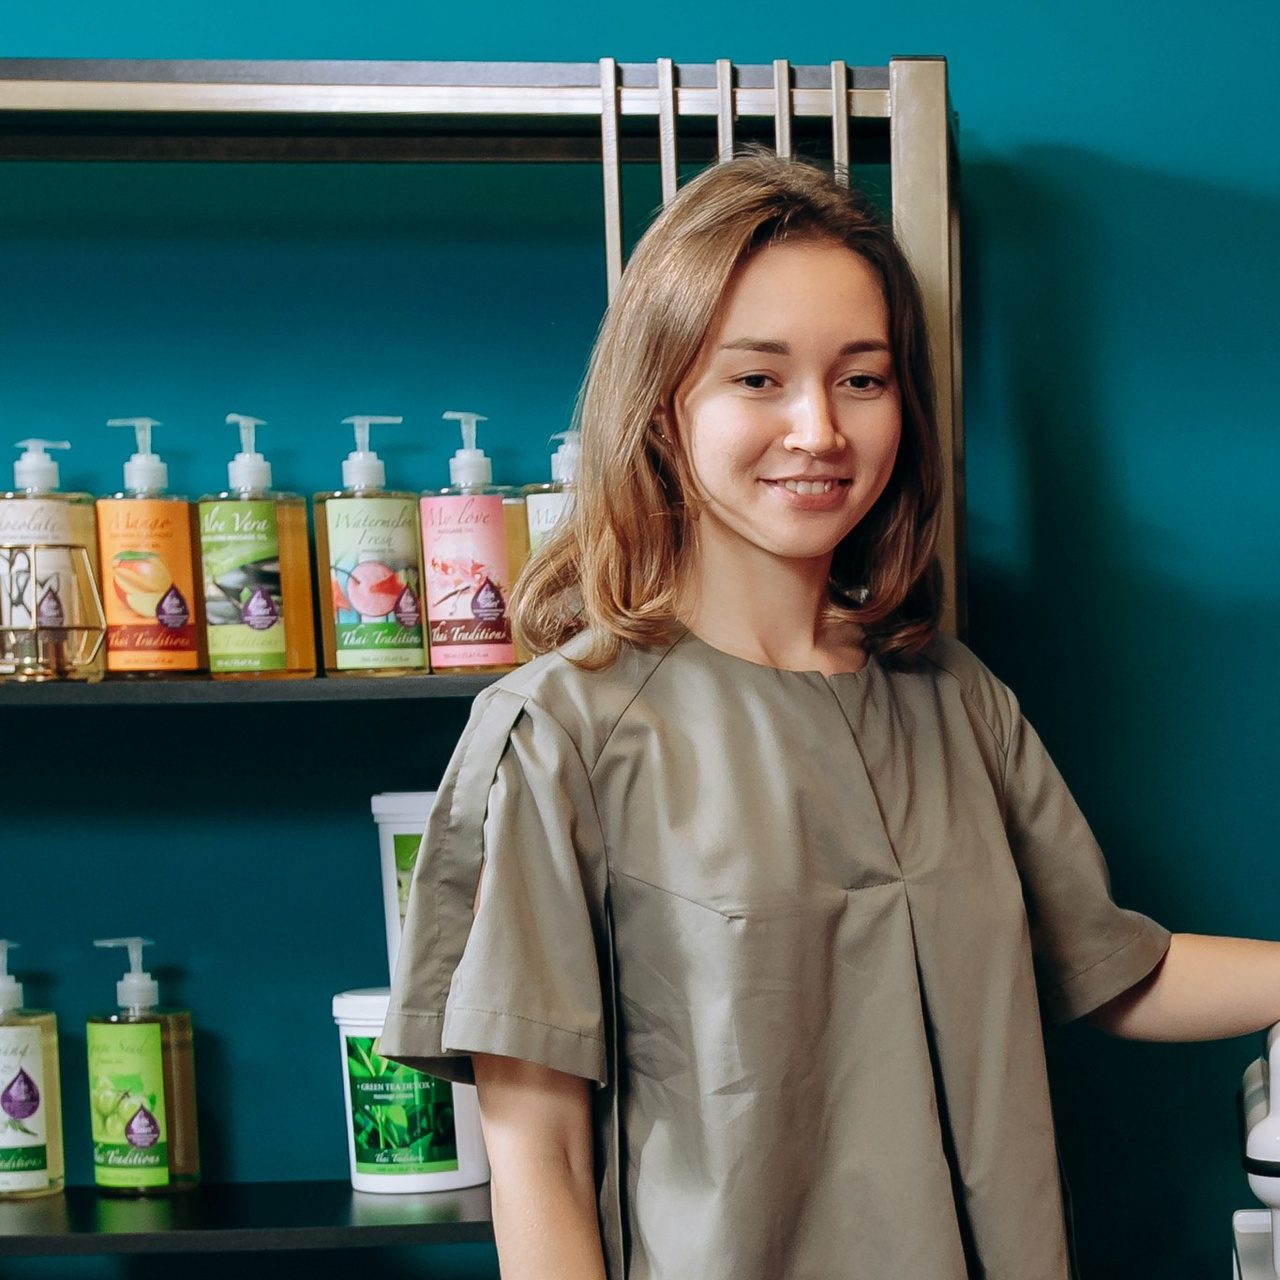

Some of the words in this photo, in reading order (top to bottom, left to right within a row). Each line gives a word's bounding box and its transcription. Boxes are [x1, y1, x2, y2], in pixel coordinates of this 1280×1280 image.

[457, 497, 491, 524] love
[232, 511, 269, 532] Vera
[136, 629, 191, 646] Traditions
[341, 624, 368, 646] Thai
[451, 621, 507, 642] Traditions
[360, 1082, 384, 1091] GREEN
[385, 1082, 400, 1091] TEA
[107, 1147, 160, 1165] Traditions
